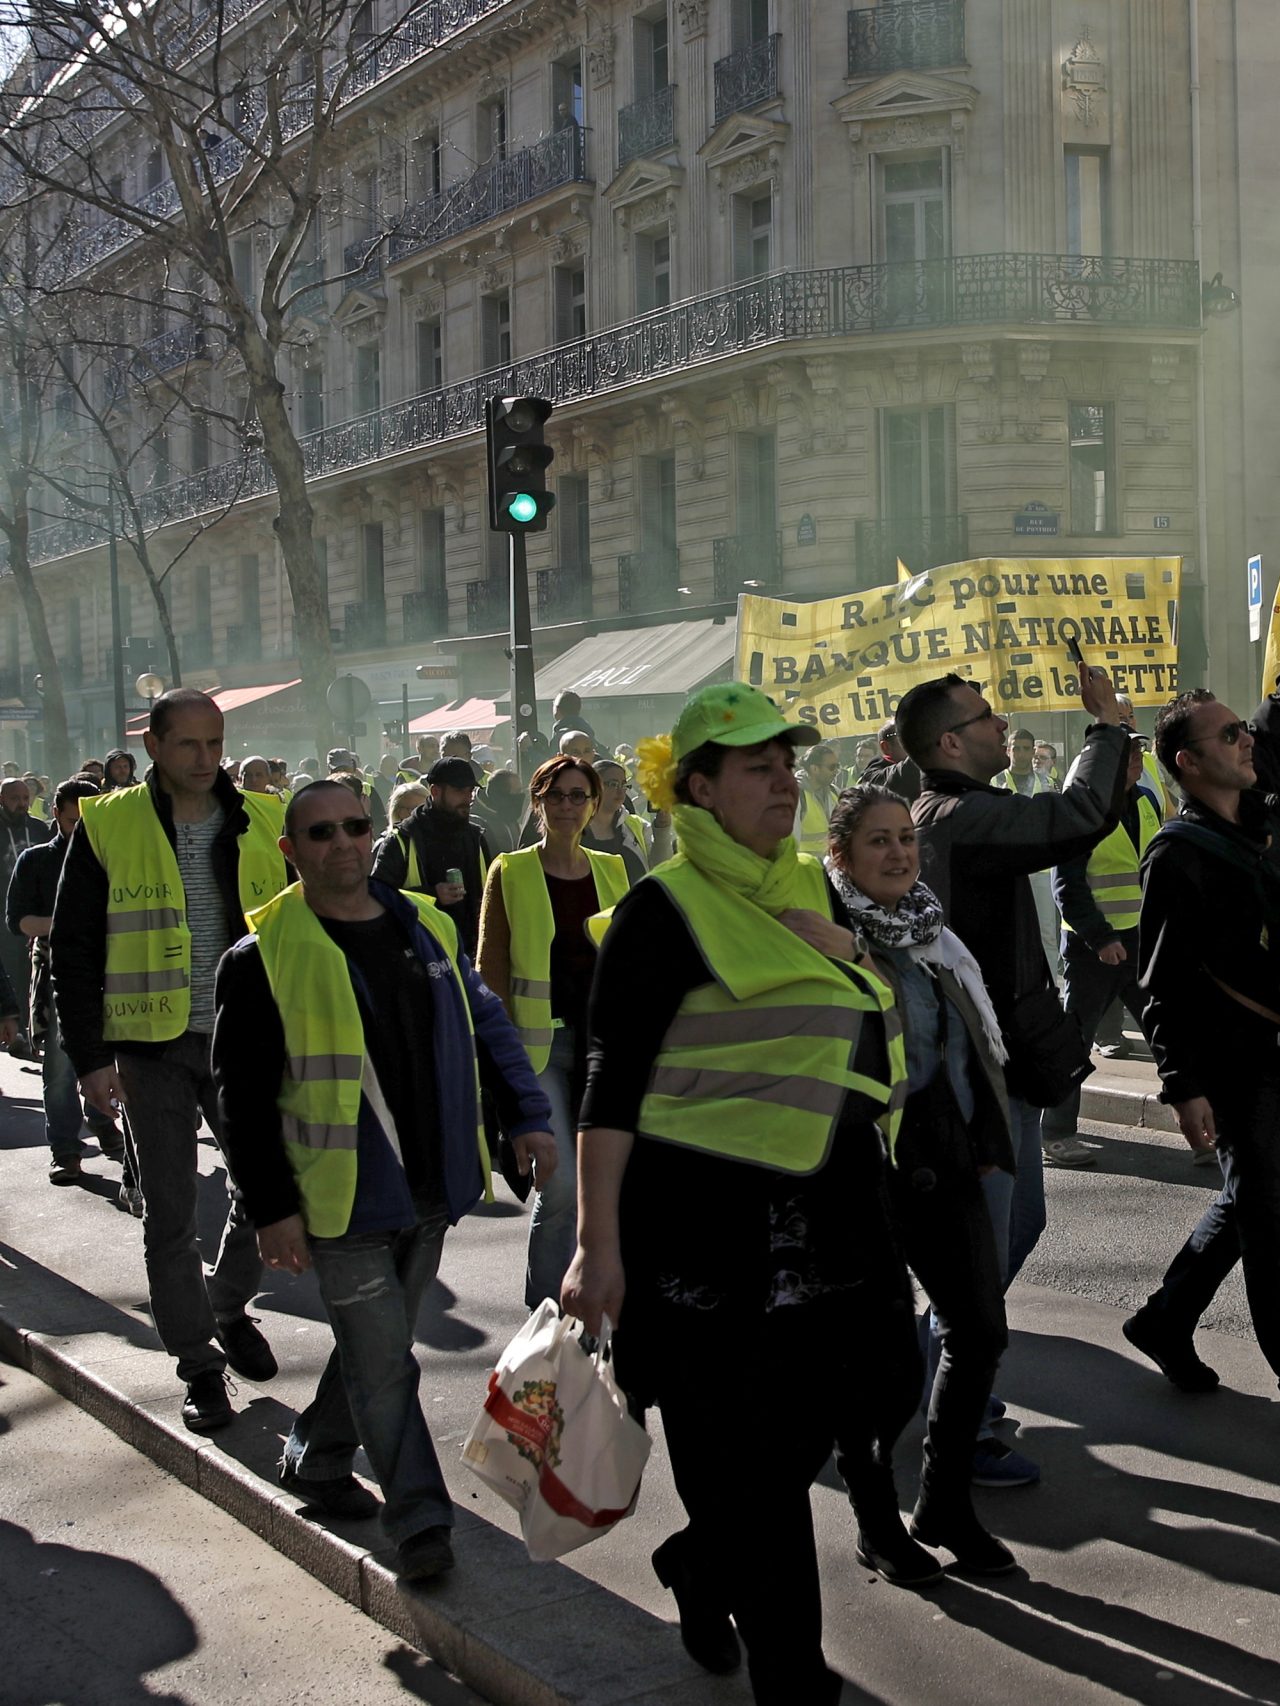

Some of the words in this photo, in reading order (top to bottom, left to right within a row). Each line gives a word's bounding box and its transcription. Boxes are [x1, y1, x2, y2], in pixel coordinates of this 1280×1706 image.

[1157, 517, 1168, 528] 15
[950, 573, 1040, 610] pour
[1047, 573, 1109, 596] une
[773, 627, 951, 684] BANQUE
[961, 616, 1163, 654] NATIONALE
[568, 664, 652, 689] PAUL
[798, 701, 841, 726] se
[998, 669, 1043, 701] de
[1050, 667, 1081, 697] la
